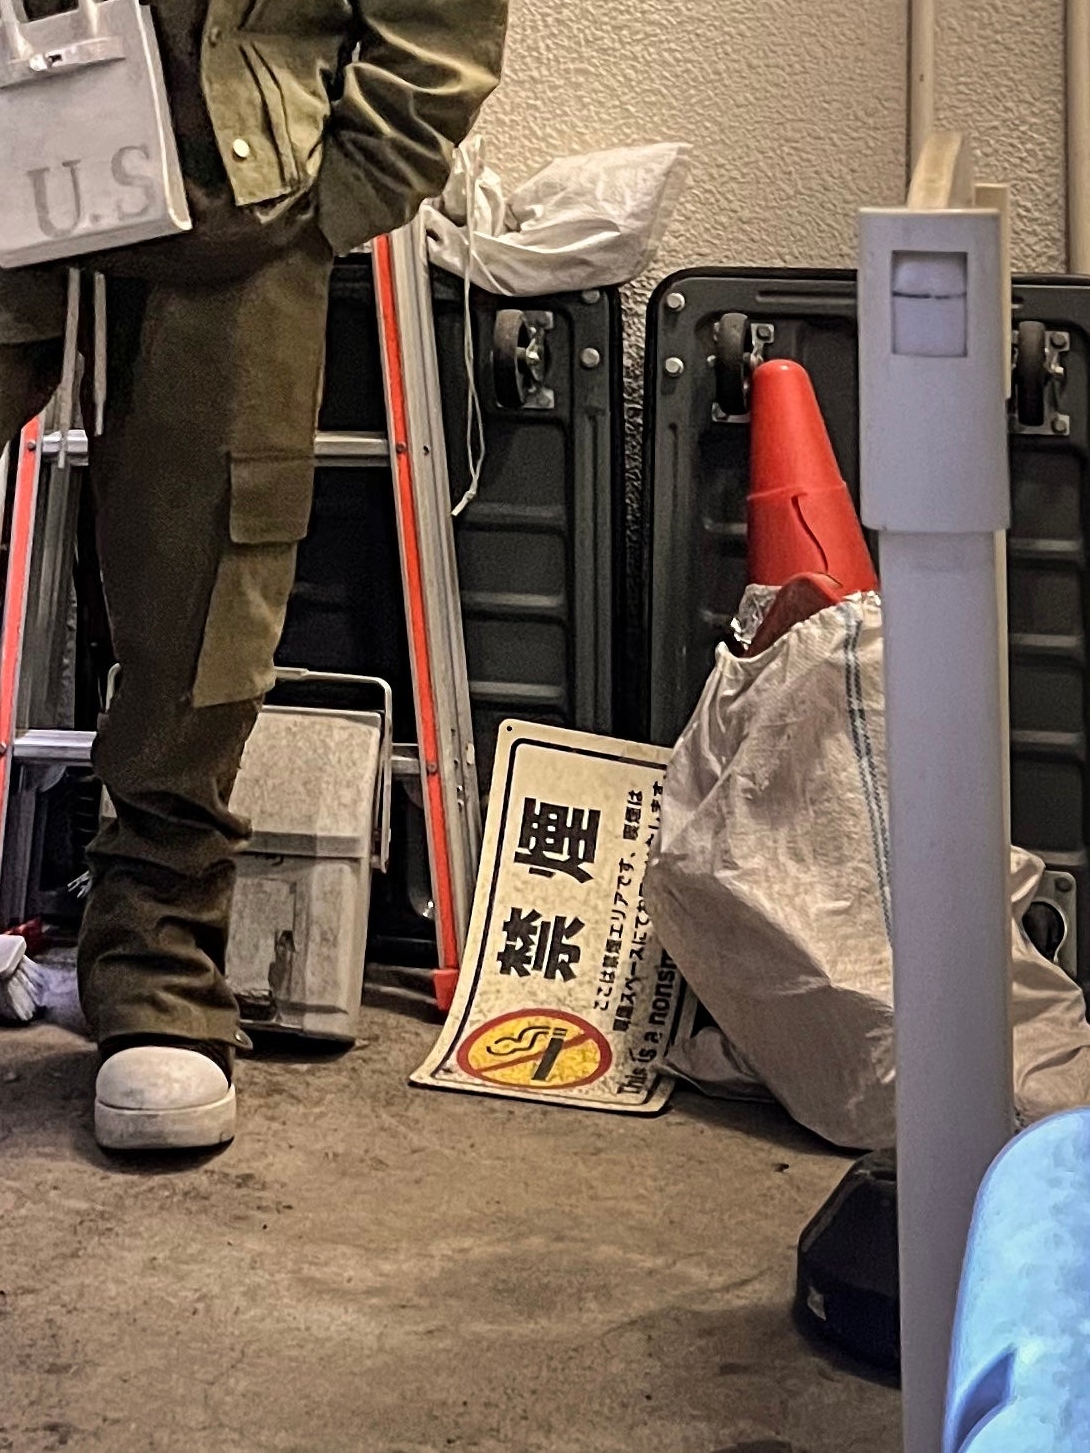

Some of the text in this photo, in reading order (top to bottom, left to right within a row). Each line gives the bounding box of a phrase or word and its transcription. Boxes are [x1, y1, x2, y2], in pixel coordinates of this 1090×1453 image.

[496, 797, 601, 982] 禁煙
[643, 1030, 663, 1045] a
[636, 1047, 658, 1064] is
[616, 1066, 649, 1095] This
